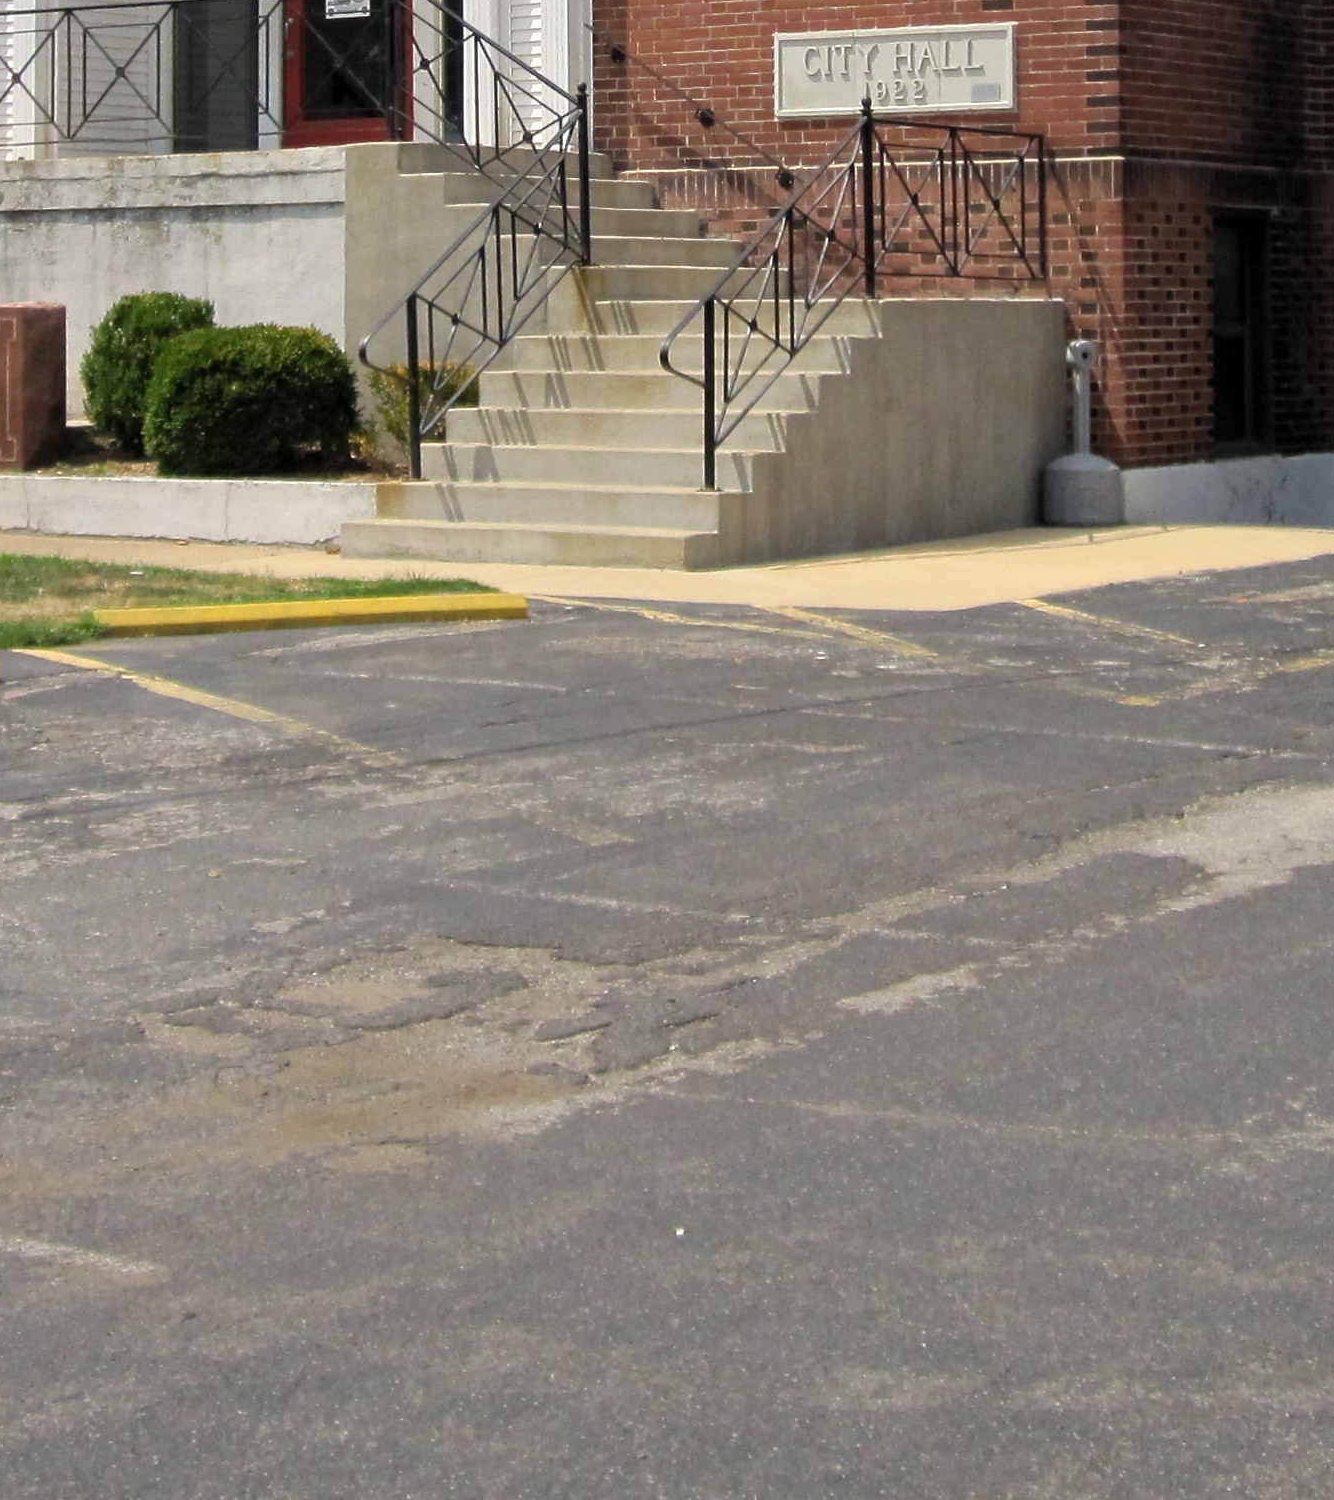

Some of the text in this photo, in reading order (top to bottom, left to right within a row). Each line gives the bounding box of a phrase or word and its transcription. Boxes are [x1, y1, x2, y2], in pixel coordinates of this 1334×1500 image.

[803, 39, 985, 80] CITY HALL
[864, 79, 928, 101] 1922
